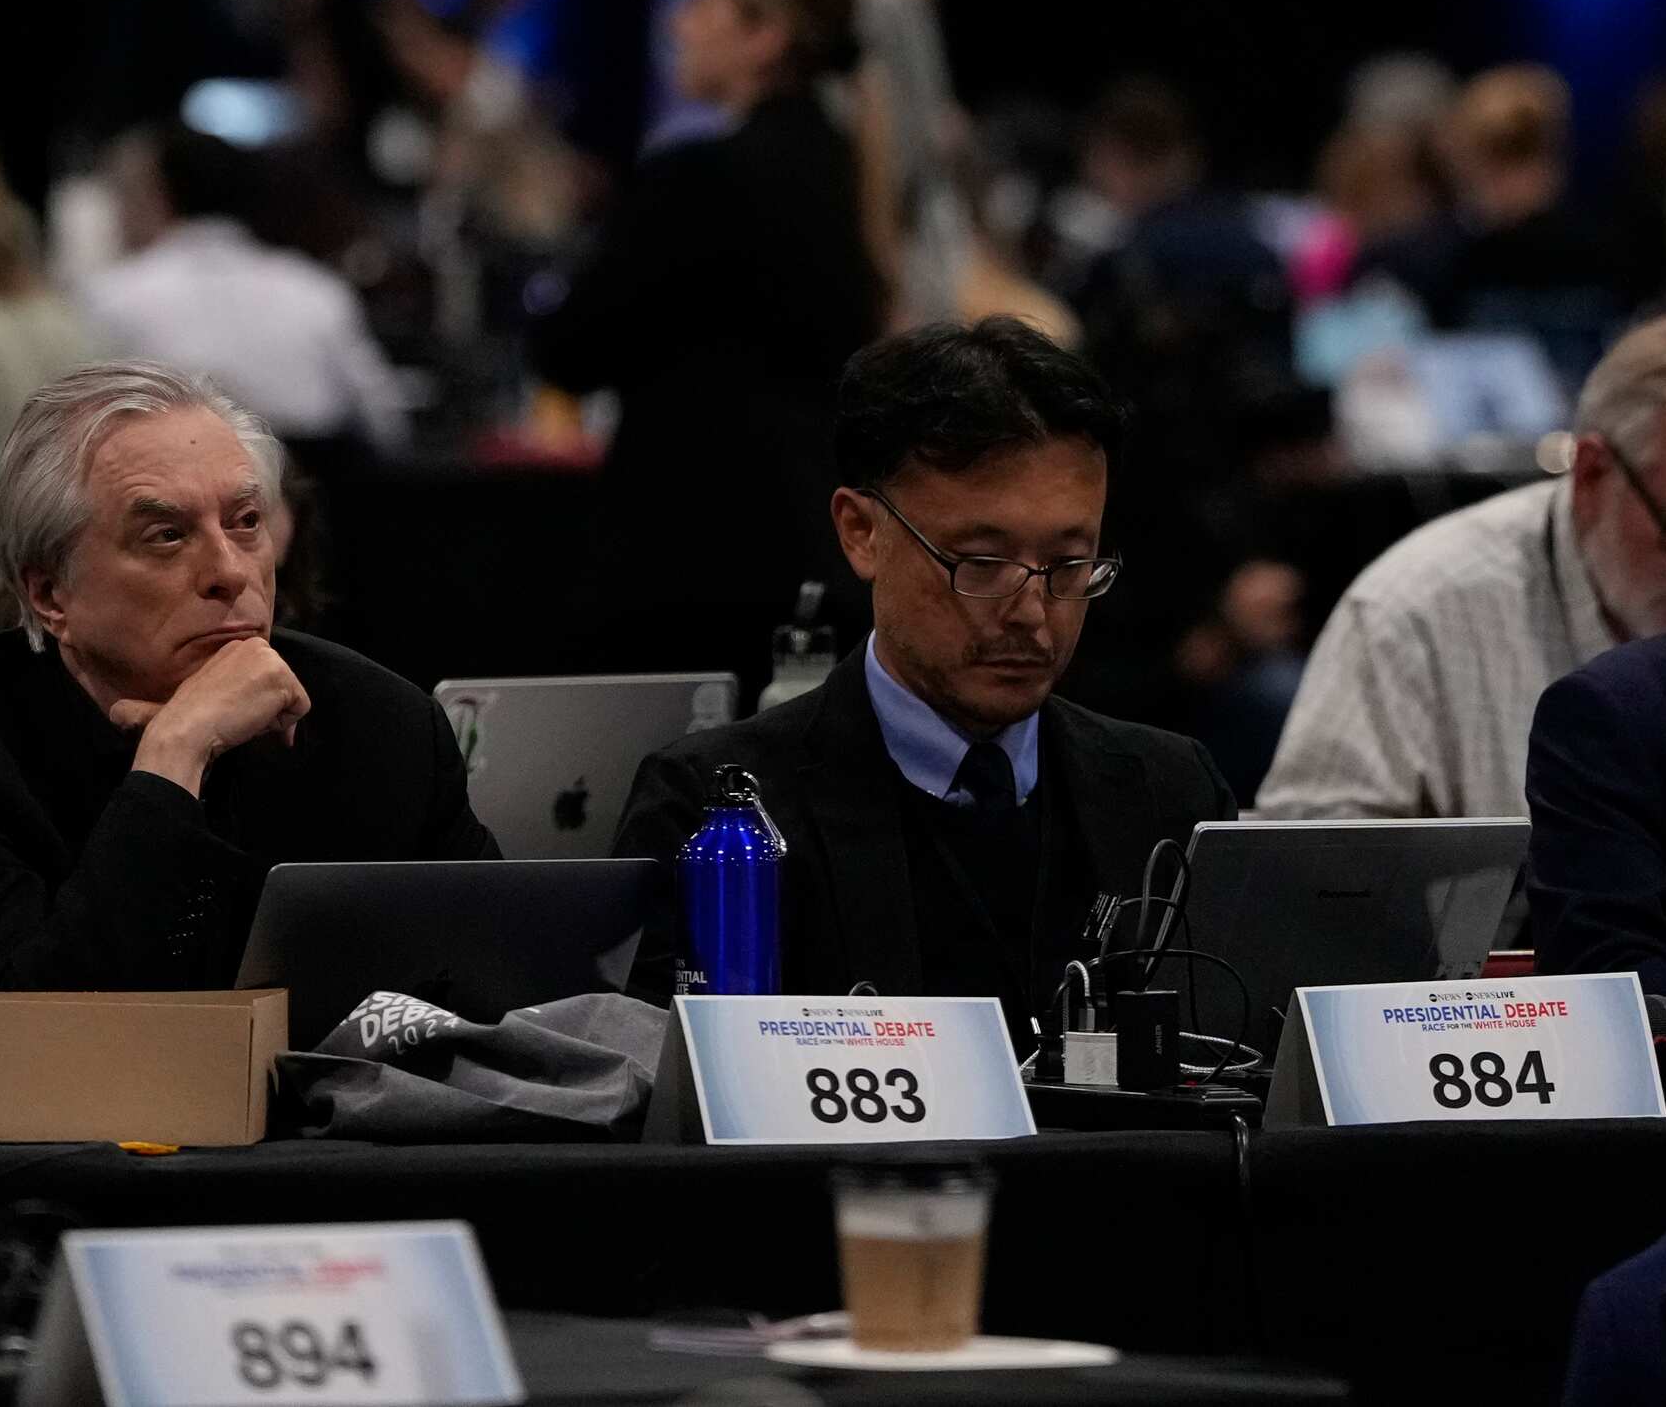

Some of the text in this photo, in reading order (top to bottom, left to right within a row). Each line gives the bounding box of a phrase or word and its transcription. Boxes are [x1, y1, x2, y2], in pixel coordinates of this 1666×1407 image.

[1383, 1002, 1569, 1024] PRESIDENTIAL DEBATE
[758, 1021, 936, 1037] PRESIDENTIAL DEBATE
[1421, 1023, 1446, 1033] RACE
[1447, 1023, 1460, 1031] FOR
[1474, 1020, 1503, 1030] WHITE
[1505, 1019, 1537, 1028] HOUSE
[796, 1037, 819, 1046] RACE
[846, 1037, 874, 1047] WHITE
[876, 1038, 906, 1047] HOUSE
[1429, 1050, 1555, 1109] 884
[806, 1068, 926, 1124] 883
[232, 1321, 377, 1390] 894
